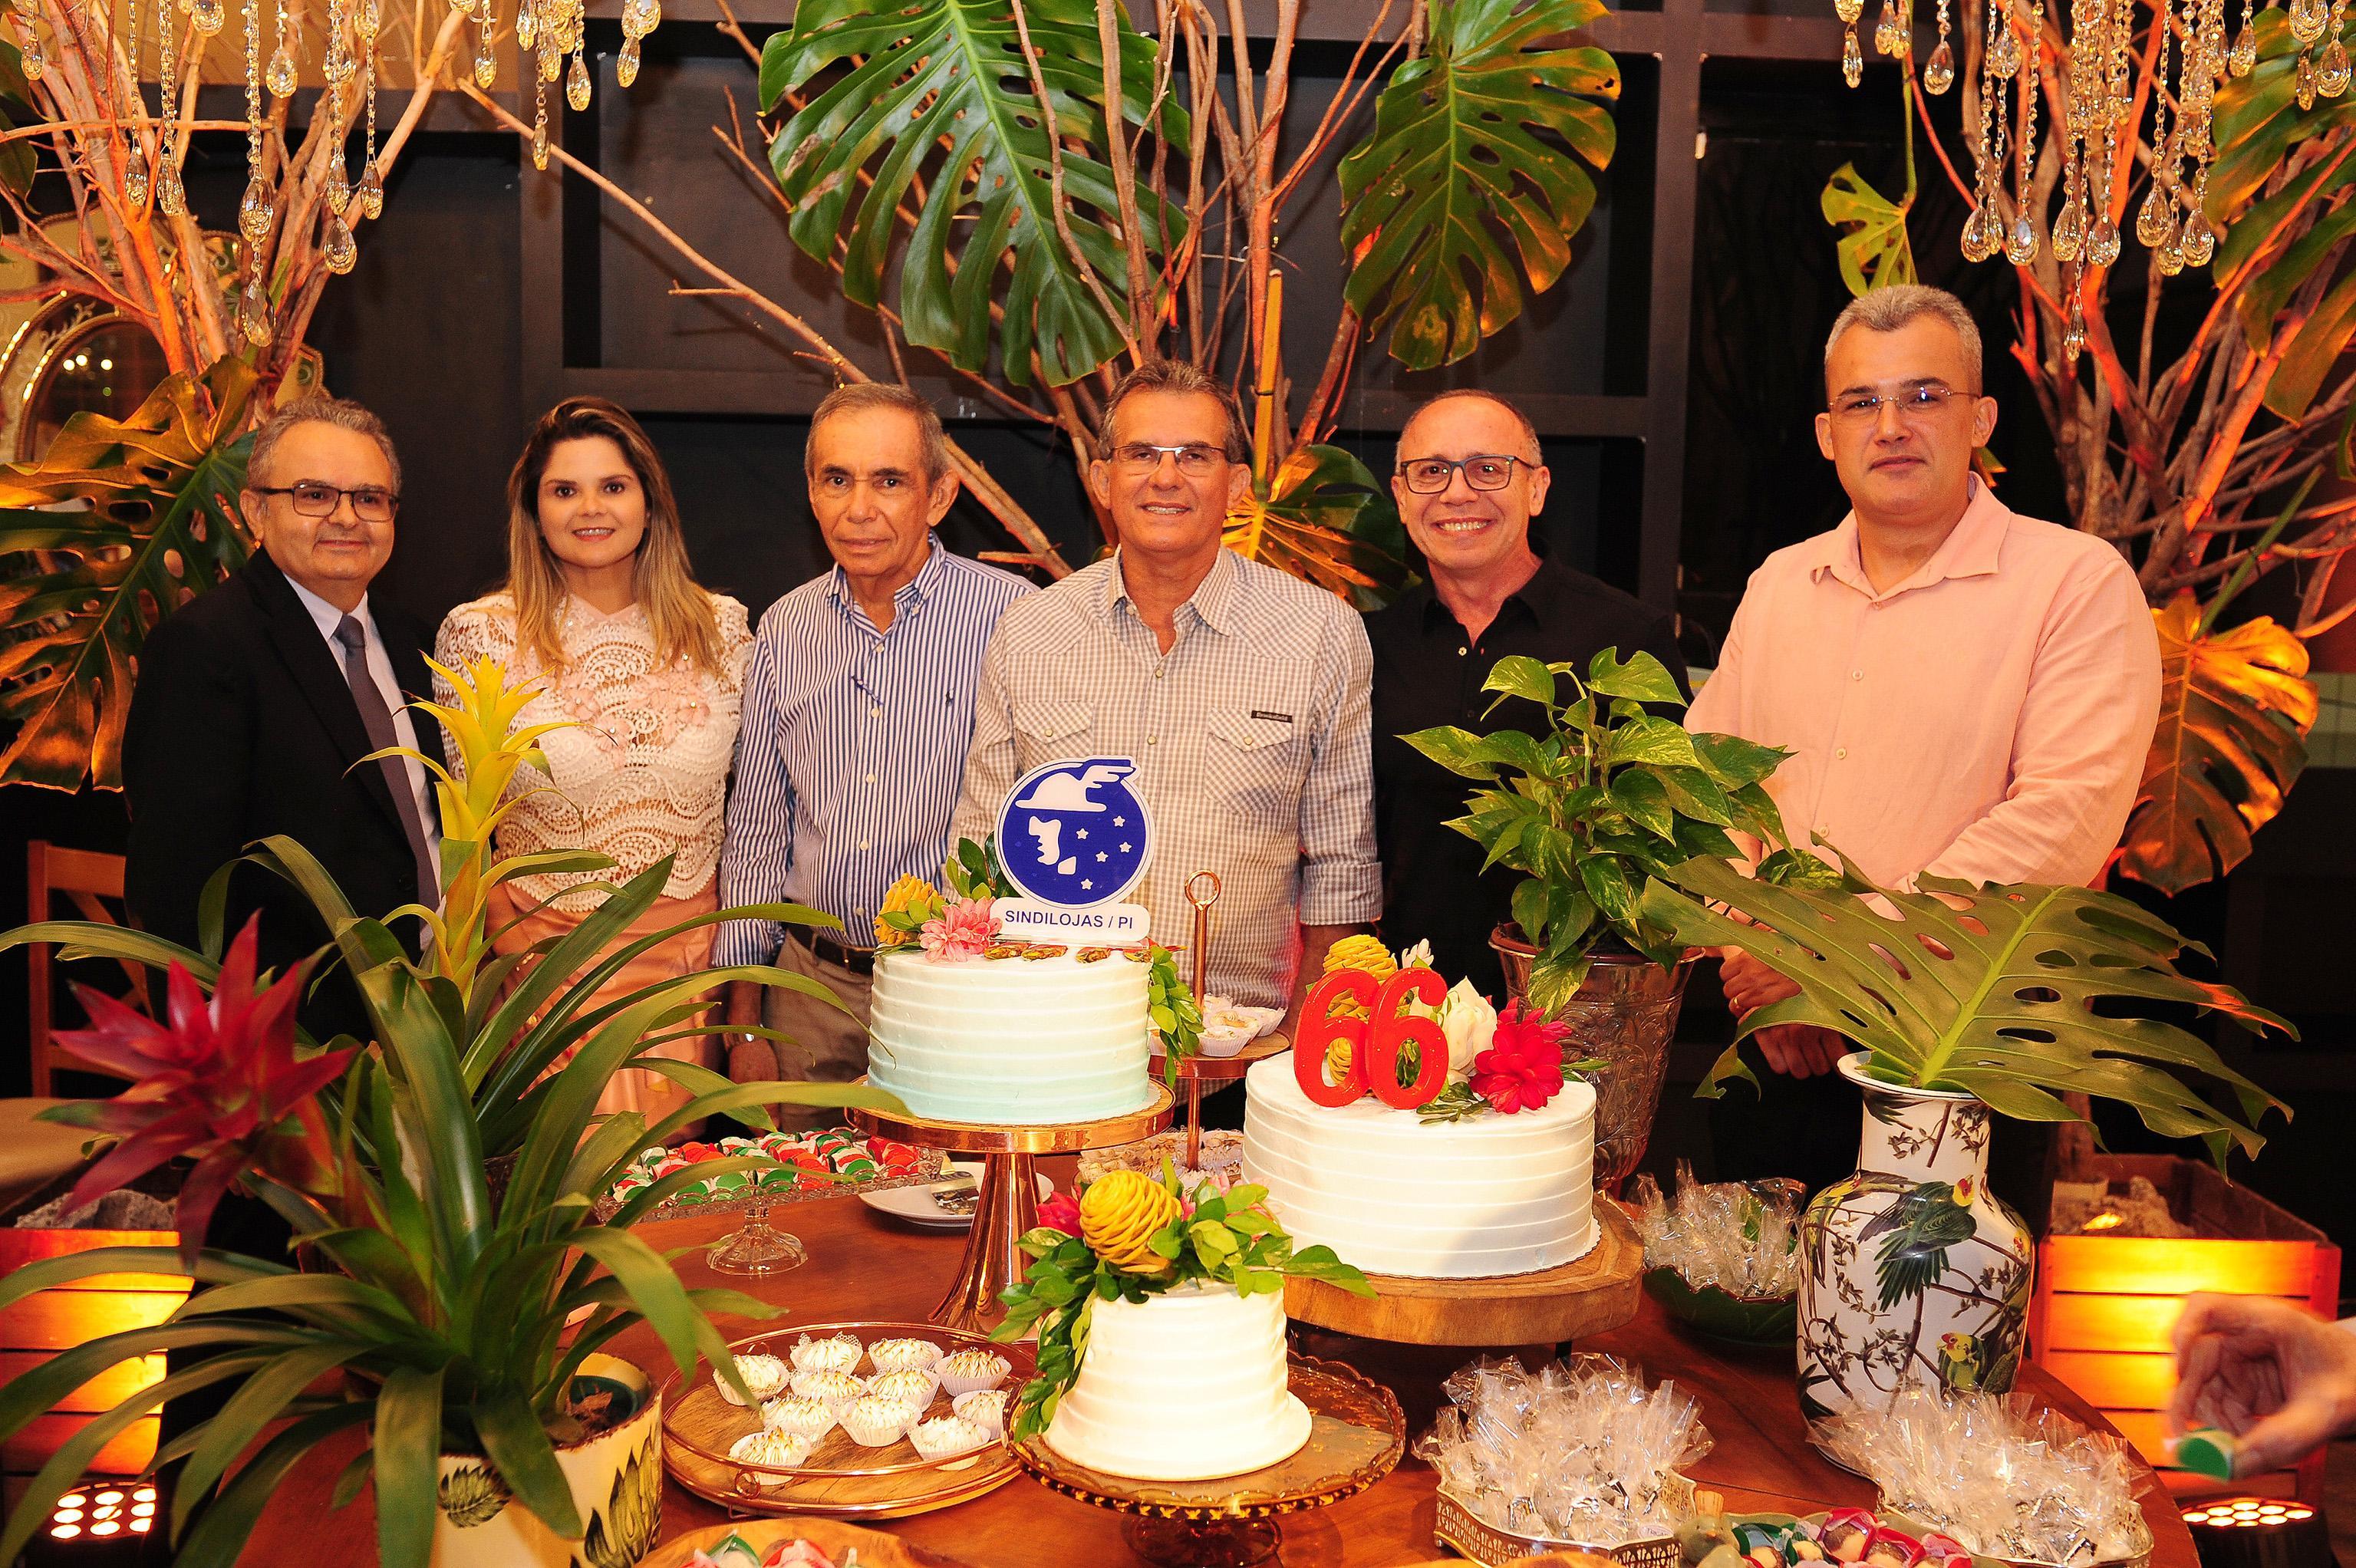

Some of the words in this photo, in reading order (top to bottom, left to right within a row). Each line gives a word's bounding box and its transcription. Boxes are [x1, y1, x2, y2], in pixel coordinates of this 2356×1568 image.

[1005, 910, 1103, 927] SINDILOJAS
[1118, 916, 1133, 929] PI
[1293, 967, 1449, 1110] 66
